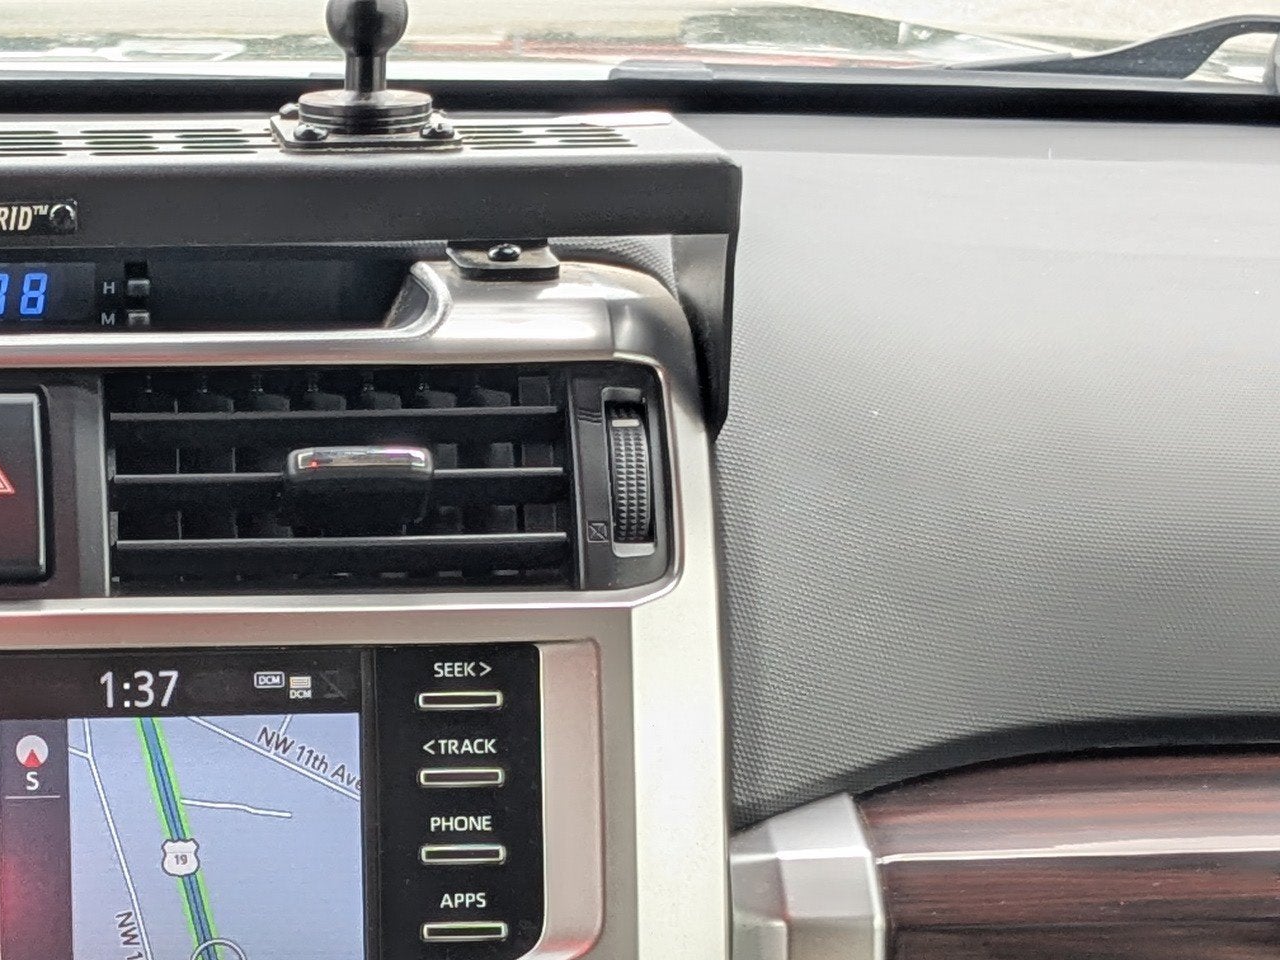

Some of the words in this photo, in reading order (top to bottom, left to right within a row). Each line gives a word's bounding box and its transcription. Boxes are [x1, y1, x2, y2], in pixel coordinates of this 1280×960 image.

[102, 281, 116, 295] H
[101, 313, 116, 325] M
[258, 675, 281, 685] DCM
[100, 670, 180, 709] 1:37
[257, 726, 295, 755] NW
[295, 744, 329, 774] 11th
[25, 771, 40, 791] S
[430, 815, 493, 832] PHONE
[174, 854, 189, 866] 19
[439, 891, 487, 909] APPS
[115, 911, 141, 946] NW
